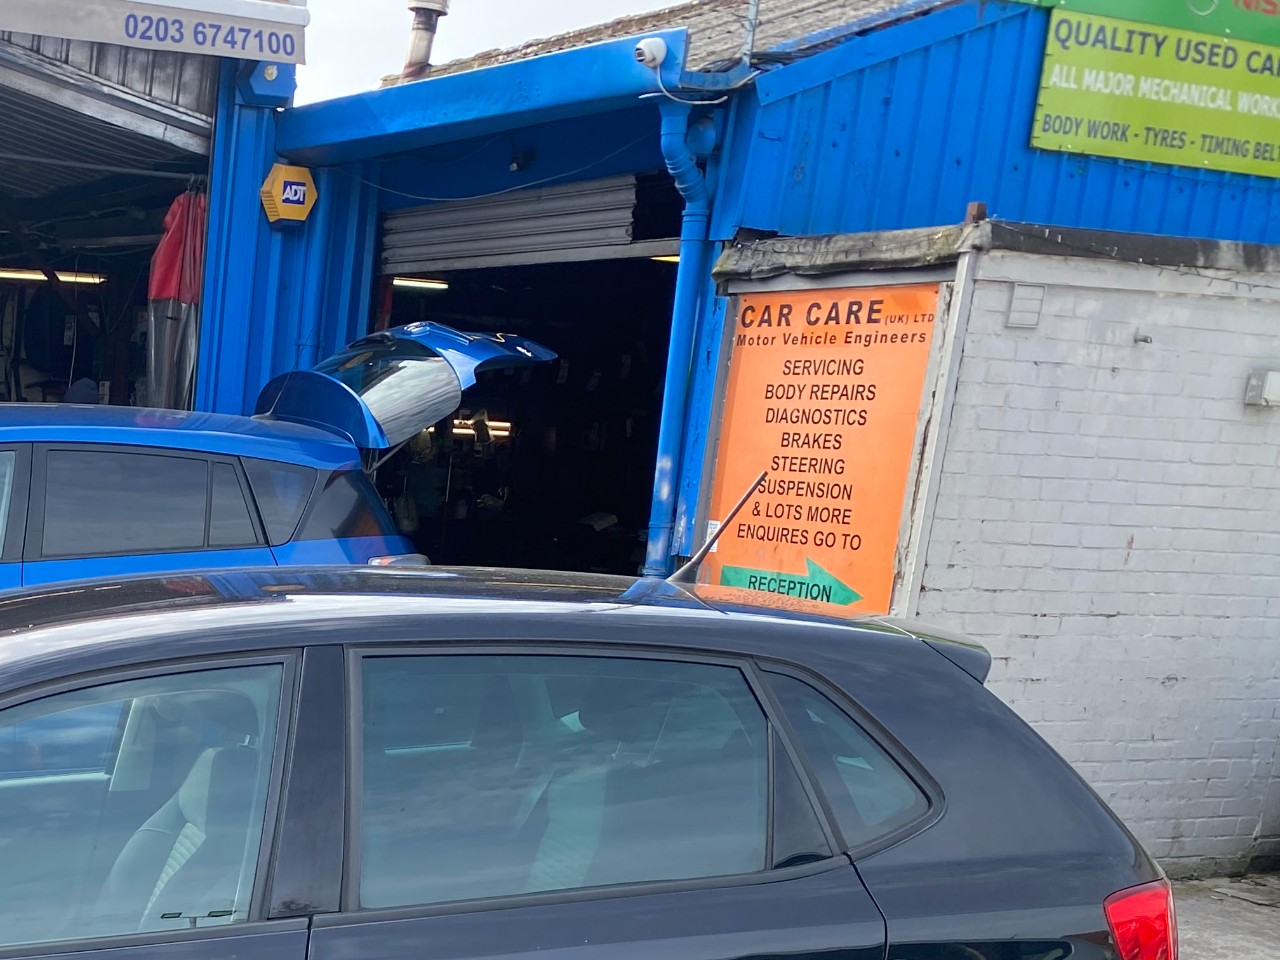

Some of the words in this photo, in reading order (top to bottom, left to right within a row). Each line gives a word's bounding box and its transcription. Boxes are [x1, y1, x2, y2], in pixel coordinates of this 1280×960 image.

[124, 14, 184, 44] 0203
[193, 21, 296, 57] 6747100
[1054, 18, 1168, 57] QUALITY
[1175, 38, 1238, 69] USED
[1049, 63, 1078, 90] ALL
[1082, 67, 1135, 97] MAJOR
[1138, 76, 1233, 112] MECHANICAL
[1042, 112, 1083, 137] BODY
[1087, 118, 1131, 143] WORK
[1144, 126, 1187, 150] TYRES
[1200, 134, 1250, 158] TIMING
[281, 184, 306, 202] ADT
[741, 303, 793, 328] CAR
[806, 300, 884, 326] CARE
[884, 313, 909, 326] (UK)
[913, 313, 935, 323] LTD
[736, 334, 777, 347] Motor
[783, 331, 837, 346] Vehicle
[844, 330, 927, 348] Engineers
[782, 359, 865, 376] SERVICING
[764, 384, 807, 400] BODY
[809, 384, 877, 401] REPAIRS
[765, 408, 868, 426] DIAGNOSTICS
[780, 432, 843, 450] BRAKES
[771, 455, 845, 475] STEERING
[758, 478, 853, 500] SUSPENSION
[751, 501, 761, 517] &
[765, 502, 803, 521] LOTS
[806, 505, 852, 525] MORE
[737, 523, 809, 545] ENQUIRES
[813, 530, 837, 548] GO
[841, 533, 862, 551] TO
[748, 574, 833, 602] RECEPTION
